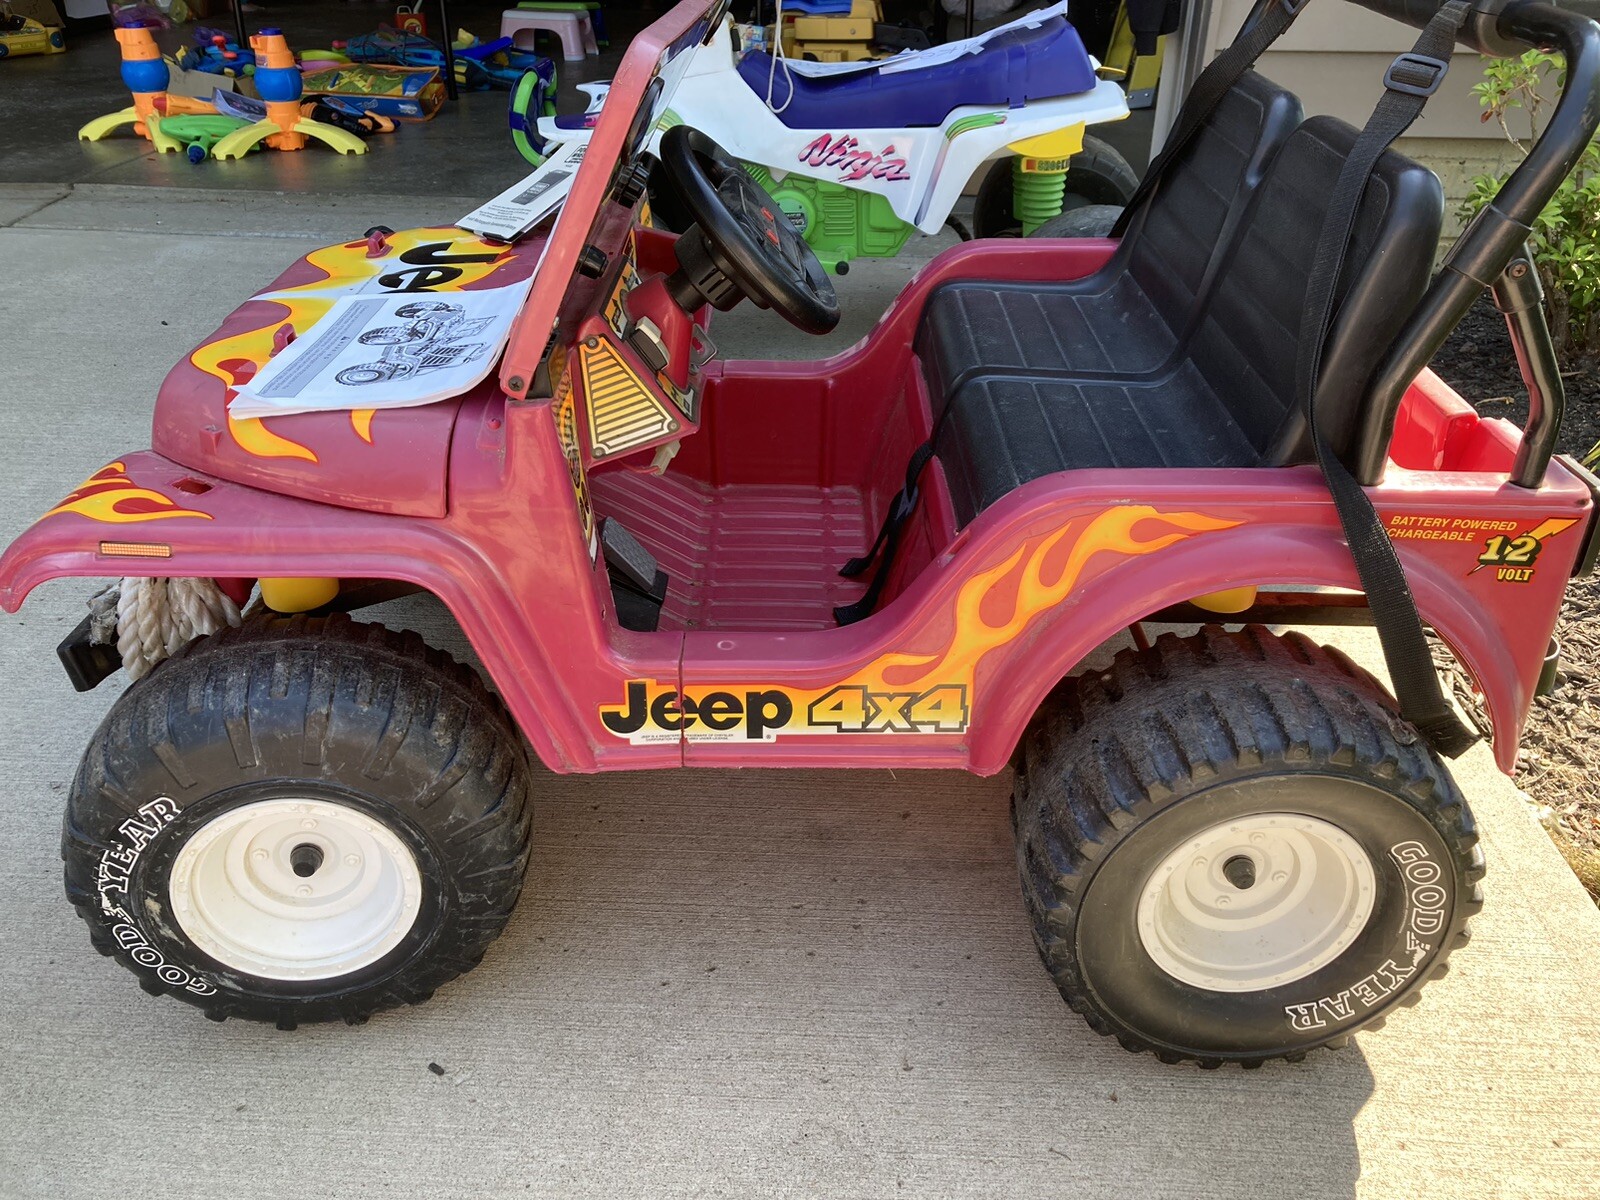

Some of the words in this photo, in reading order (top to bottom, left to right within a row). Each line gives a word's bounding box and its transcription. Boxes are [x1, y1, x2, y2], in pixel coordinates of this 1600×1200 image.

[797, 133, 911, 183] Ninja
[377, 241, 500, 295] Je
[1385, 527, 1476, 542] CHARGEABLE
[1390, 514, 1452, 528] BATTERY
[1451, 518, 1518, 531] POWERED
[1478, 534, 1542, 567] 12
[1496, 568, 1535, 583] VOLT
[601, 680, 794, 740] Jeep
[807, 684, 969, 733] 4x4
